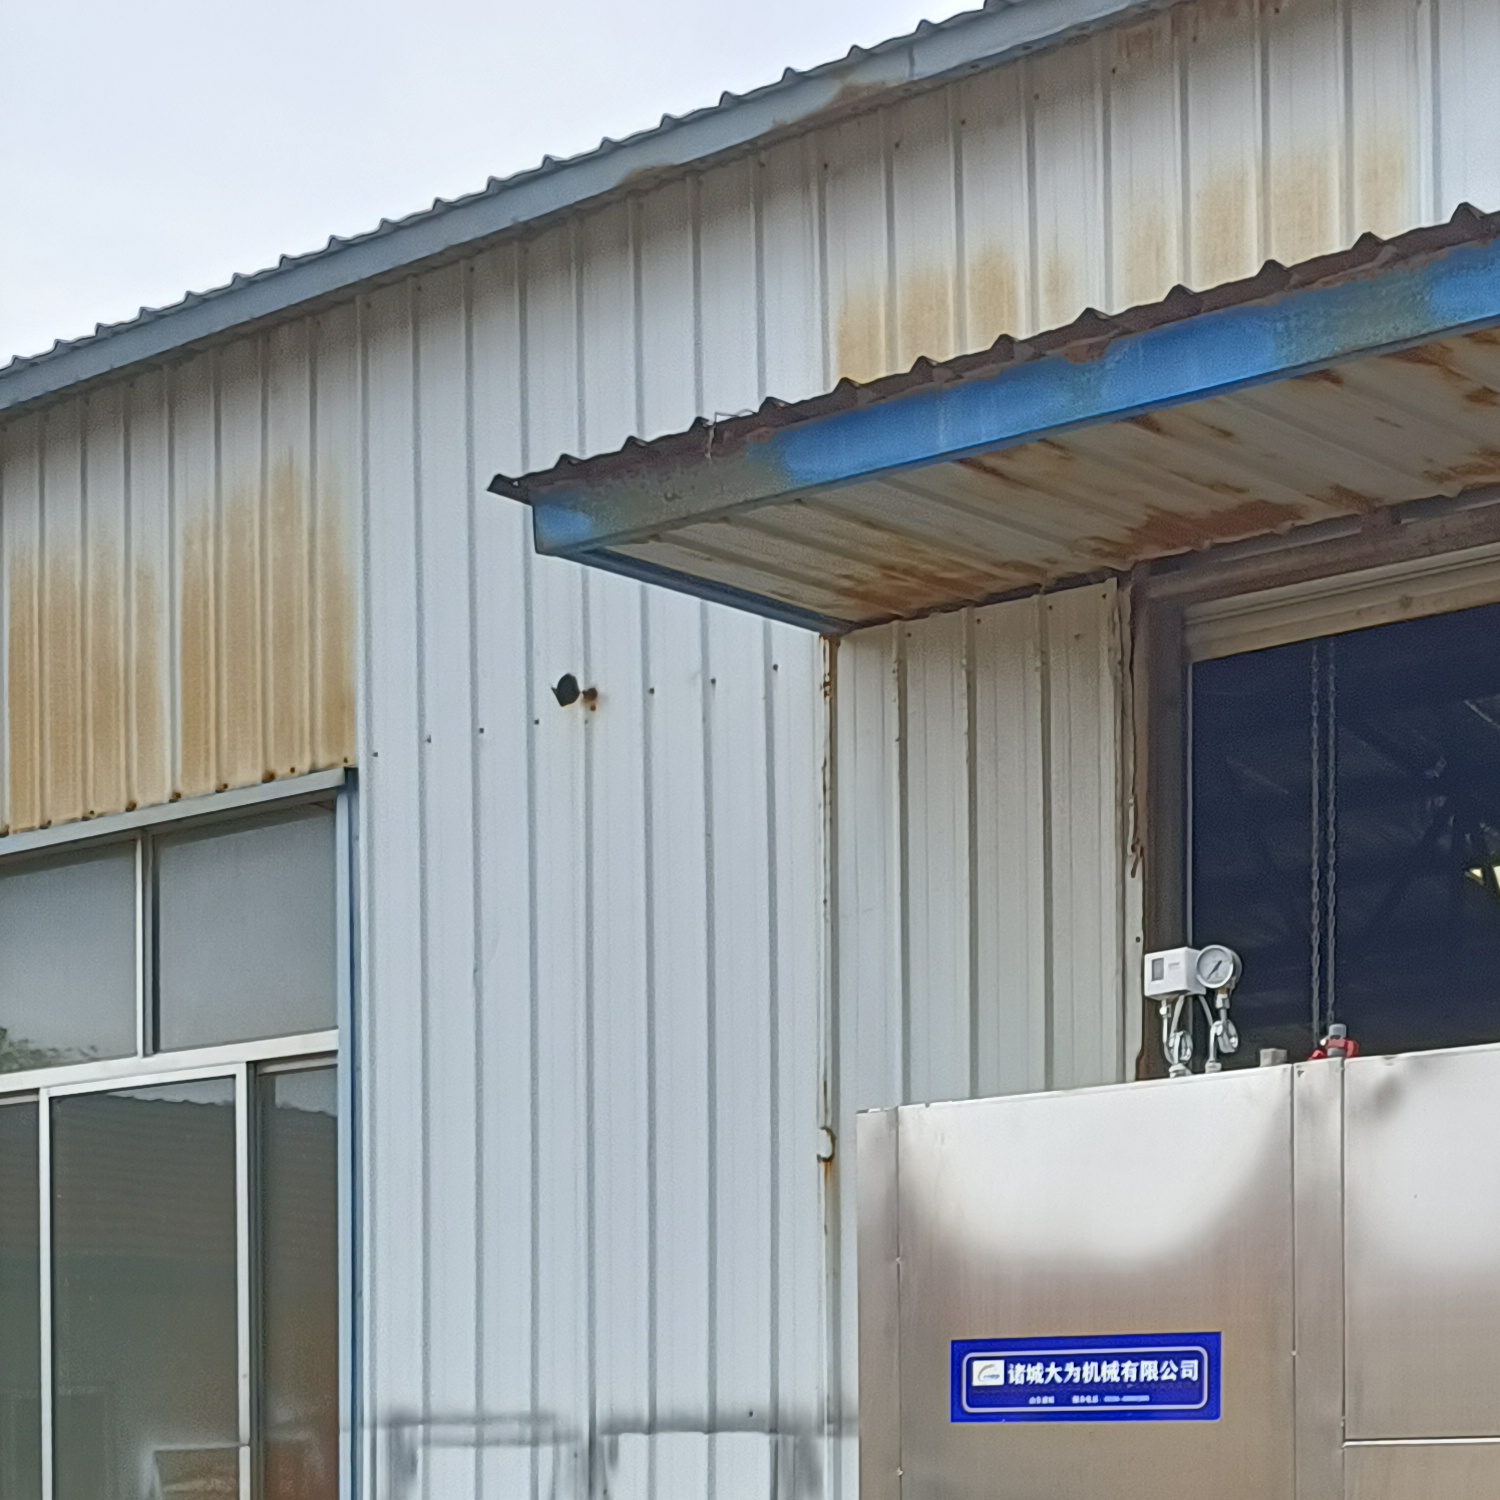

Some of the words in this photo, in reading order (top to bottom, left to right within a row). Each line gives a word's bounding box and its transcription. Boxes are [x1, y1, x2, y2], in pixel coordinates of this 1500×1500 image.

[1008, 1359, 1199, 1385] 诸城大为机械有限公司
